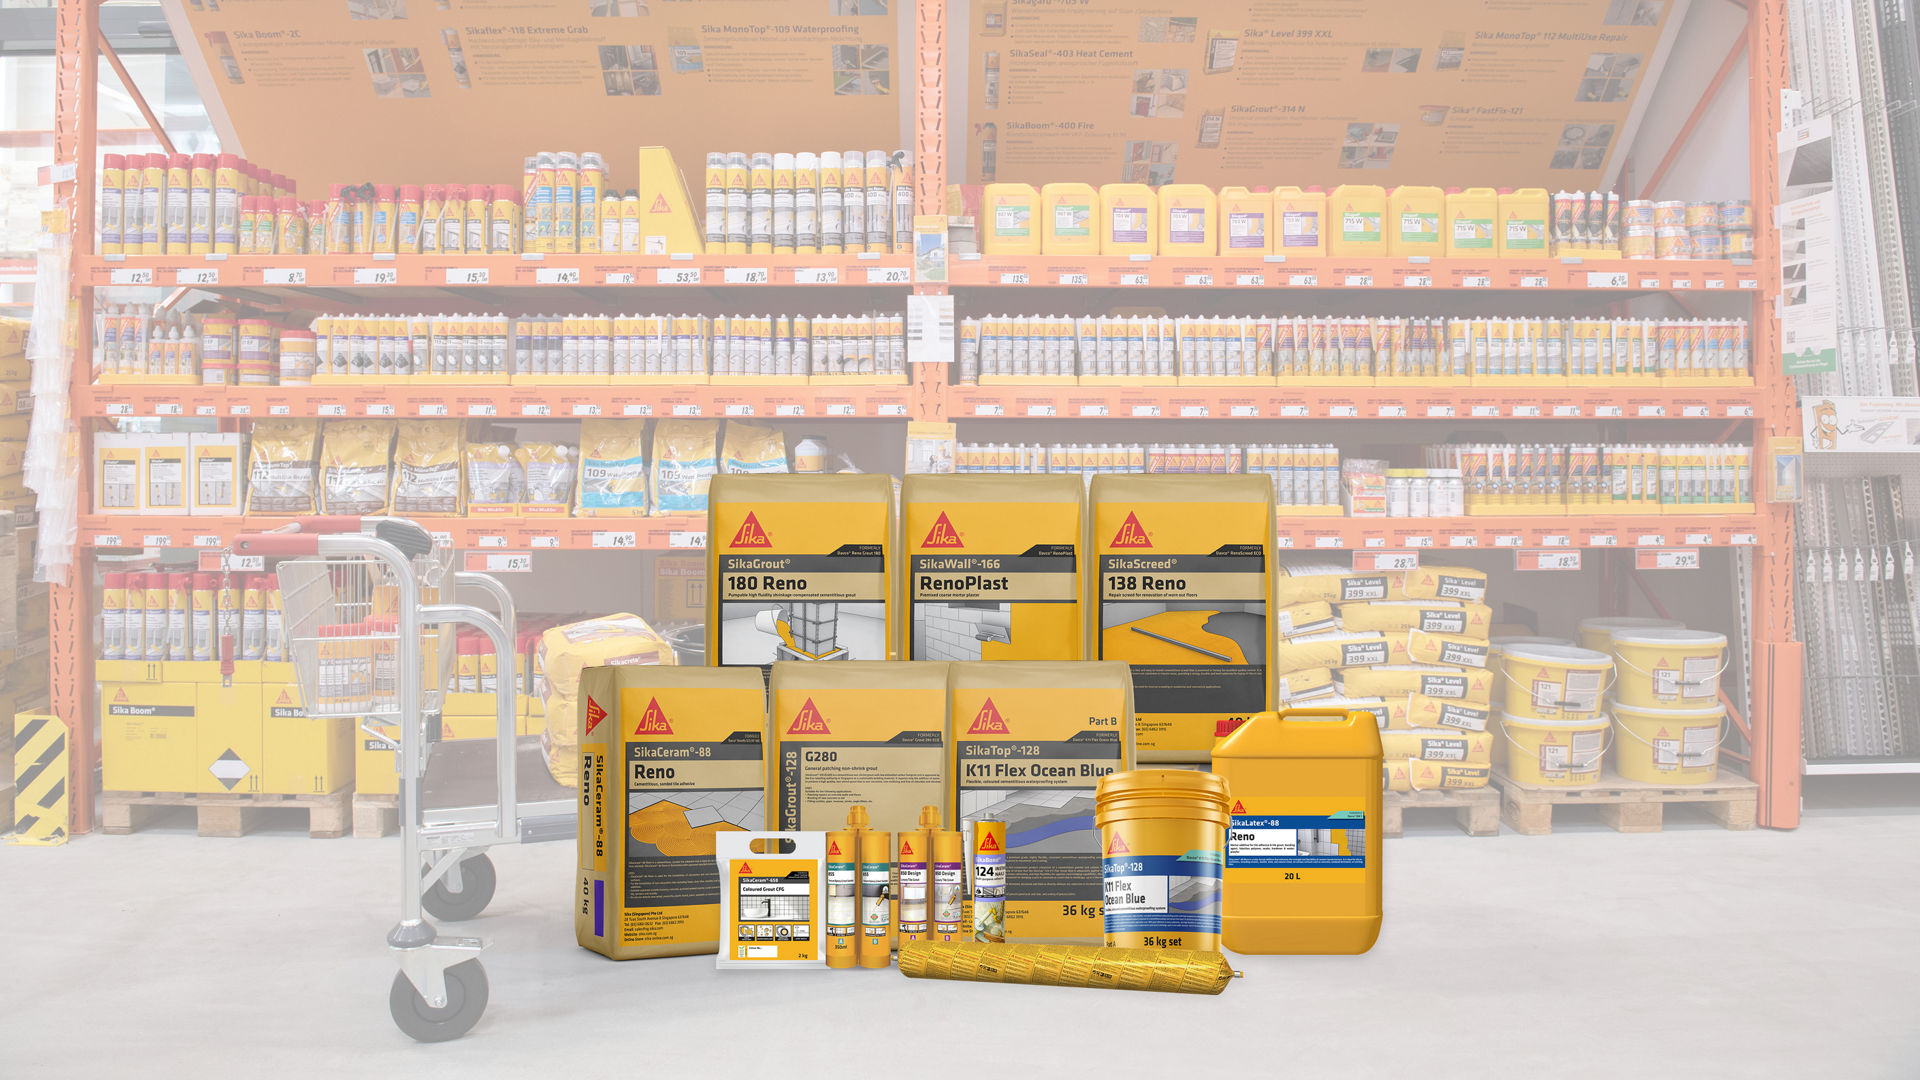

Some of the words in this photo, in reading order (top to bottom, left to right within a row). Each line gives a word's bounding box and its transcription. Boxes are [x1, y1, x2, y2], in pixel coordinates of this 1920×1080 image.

[233, 30, 253, 39] Sika
[527, 25, 565, 36] Extreme
[567, 25, 589, 36] Grab
[701, 25, 721, 36] Sika
[792, 25, 860, 36] Waterproofing
[1271, 29, 1293, 38] Level
[1475, 32, 1494, 42] Sika
[1600, 32, 1628, 42] Repair
[1076, 49, 1097, 59] Heat
[1098, 49, 1134, 59] Cement
[1078, 121, 1095, 131] Fire
[728, 558, 791, 570] SikaGrout®
[920, 558, 1001, 570] SikaWall®-166
[1108, 558, 1178, 570] SikaScreed®
[728, 576, 758, 591] 180
[763, 576, 807, 591] Reno
[920, 576, 1009, 591] RenoPlast
[1108, 576, 1137, 591] 138
[1142, 576, 1186, 591] Reno
[1347, 588, 1363, 597] 399
[1425, 621, 1441, 630] 399
[1349, 655, 1365, 664] 399
[1427, 686, 1442, 695] 399
[113, 706, 128, 715] Sika
[1089, 717, 1109, 726] Part
[1110, 717, 1118, 726] B
[634, 745, 712, 758] SikaCeram®-88
[805, 751, 838, 762] G280
[966, 745, 1040, 758] SikaTop®-128
[634, 764, 675, 780] Reno
[966, 763, 992, 777] K11
[995, 763, 1027, 777] Flex
[1030, 763, 1076, 777] Ocean
[1080, 763, 1114, 777] Blue
[583, 754, 593, 807] Reno
[785, 752, 797, 831] kaGrout®-128
[1231, 832, 1255, 841] Reno
[976, 866, 994, 877] 124
[1115, 882, 1132, 893] Flex
[1125, 893, 1146, 904] Blue
[1063, 905, 1077, 916] 36
[1081, 905, 1096, 919] kg
[1143, 937, 1154, 947] 36
[1156, 937, 1167, 949] kg
[1169, 938, 1183, 947] set
